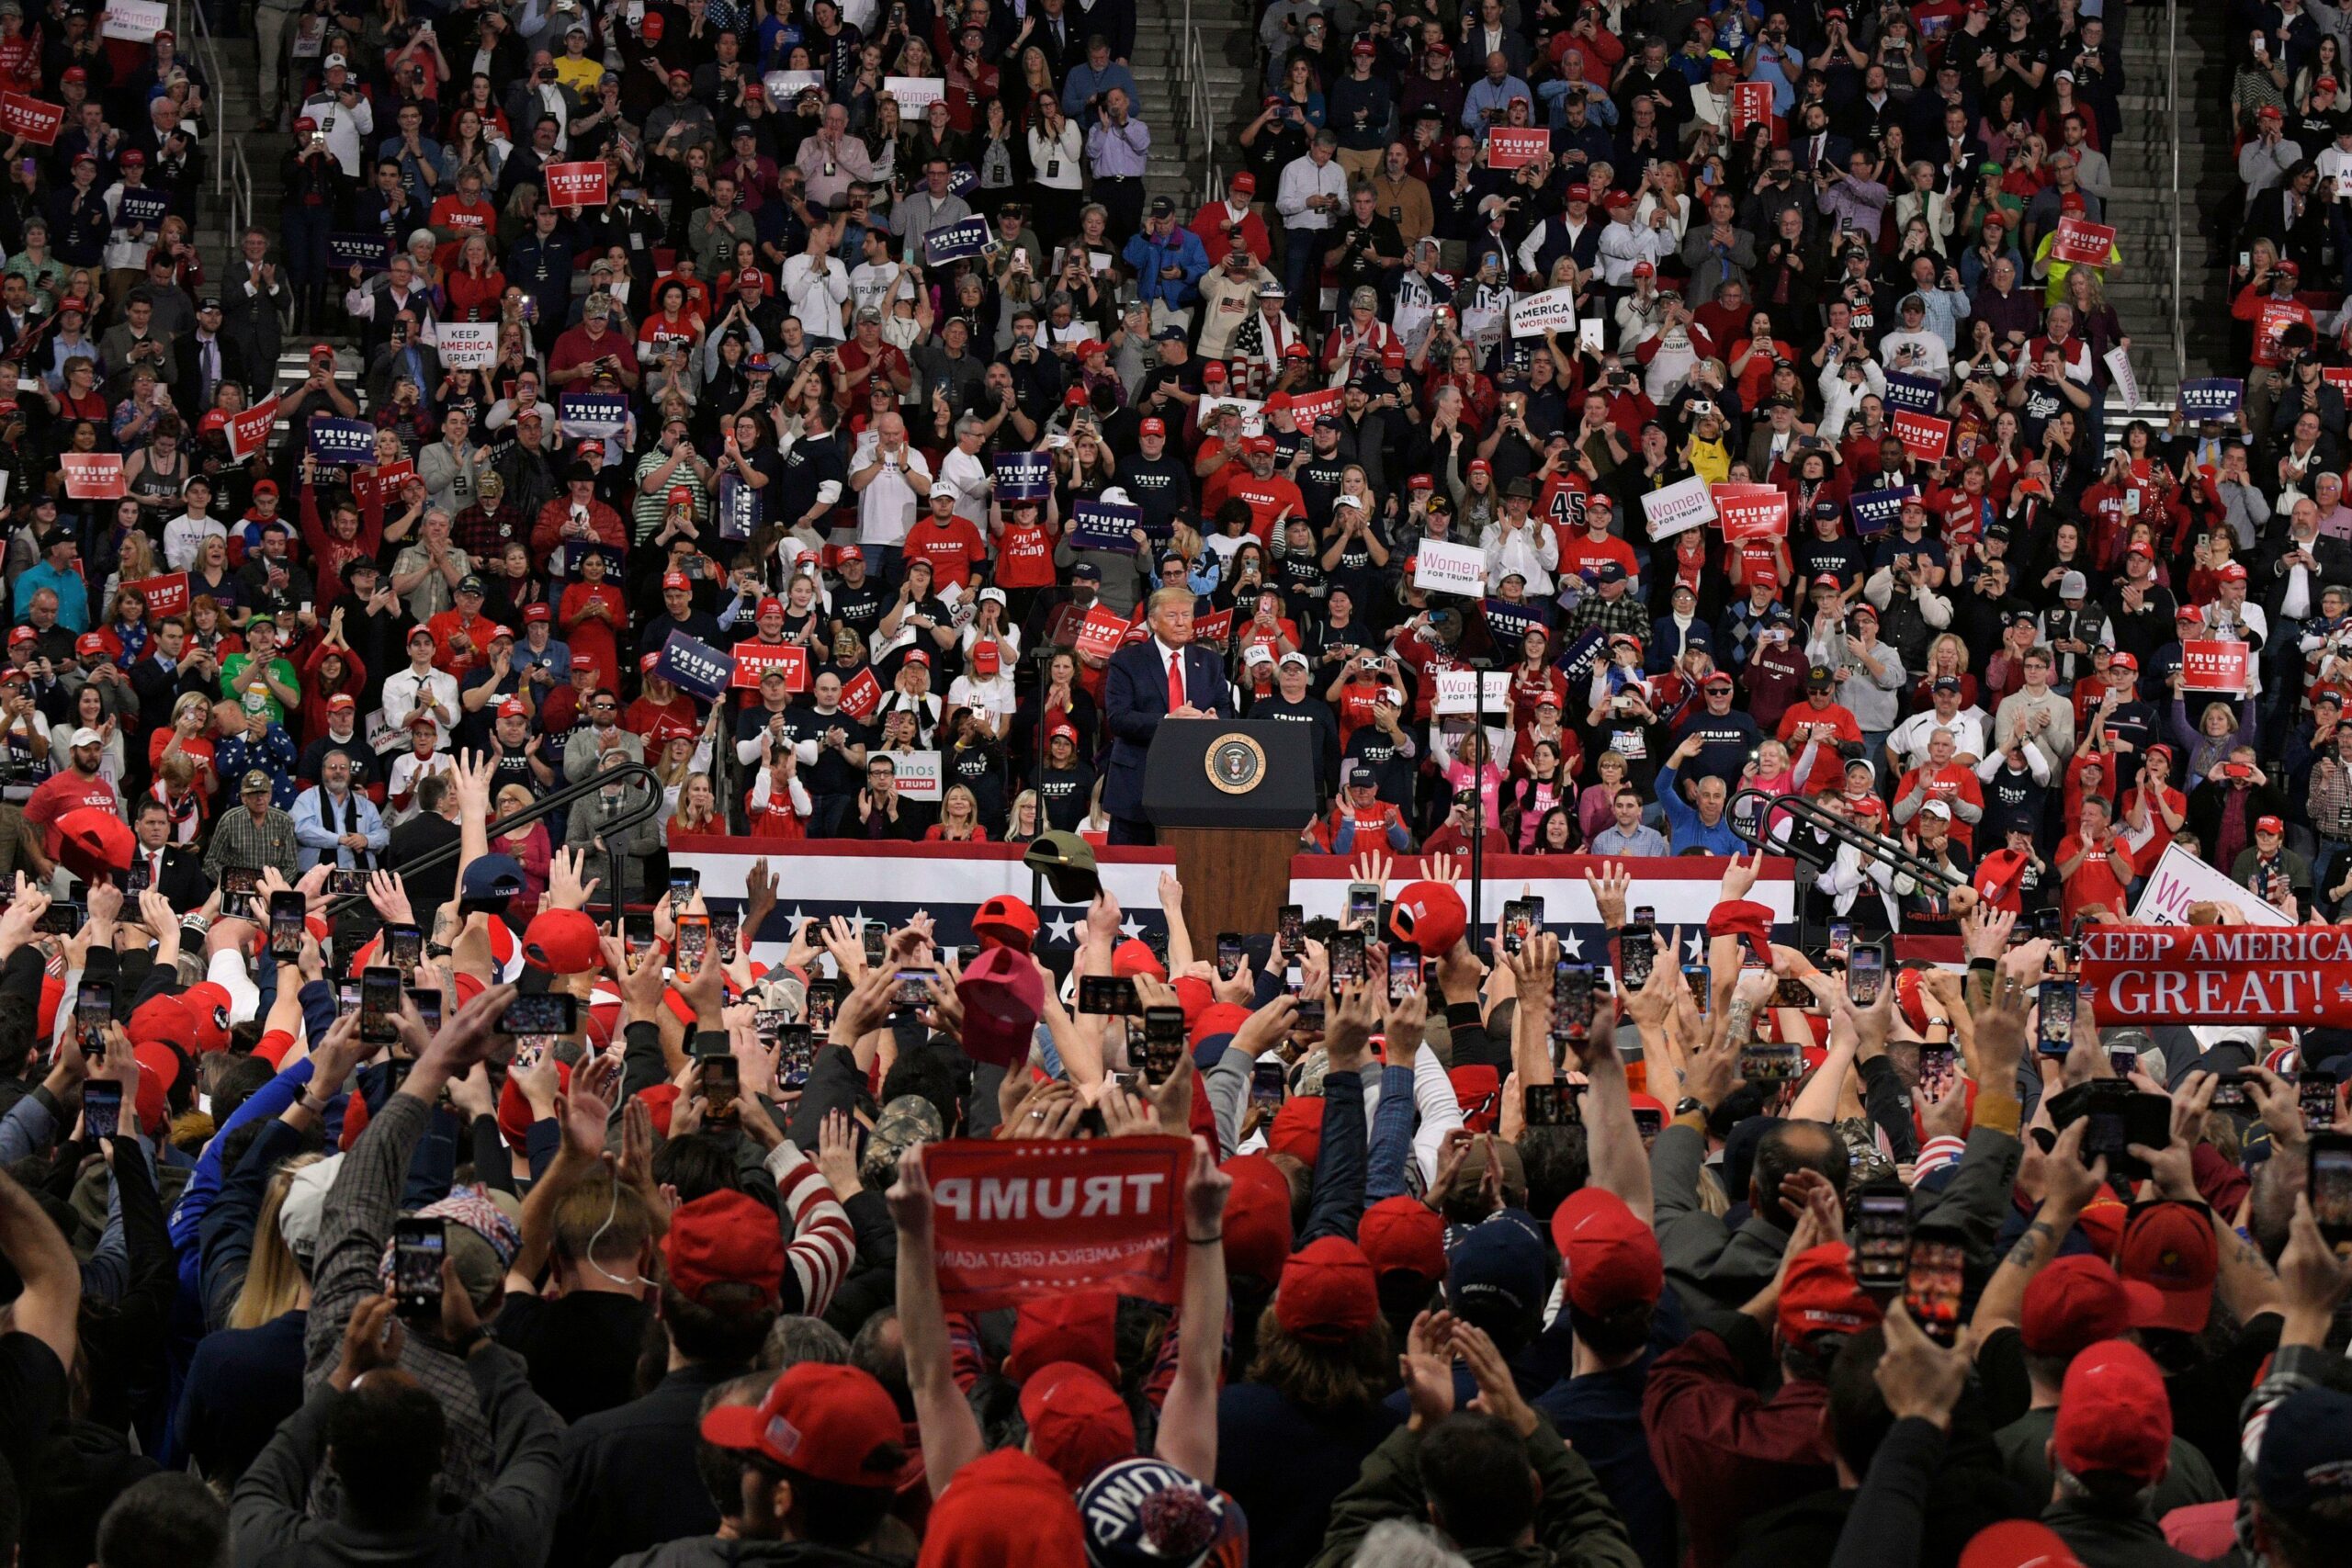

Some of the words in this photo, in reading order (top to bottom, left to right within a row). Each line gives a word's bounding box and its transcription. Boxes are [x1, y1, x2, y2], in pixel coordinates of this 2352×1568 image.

[5, 105, 55, 123] TRUMP
[7, 114, 49, 130] PENCE
[1494, 139, 1545, 148] TRUMP
[552, 174, 603, 185] TRUMP
[125, 199, 166, 210] TRUMP
[450, 214, 483, 223] TRUMP
[930, 229, 982, 247] TRUMP
[935, 236, 979, 249] PENCE
[2064, 230, 2108, 246] TRUMP
[331, 240, 385, 251] TRUMP
[2064, 238, 2101, 251] PENCE
[337, 247, 381, 256] PENCE
[854, 285, 888, 293] TRUMP
[1527, 294, 1553, 307] KEEP
[1514, 303, 1570, 320] AMERICA
[1518, 316, 1568, 329] WORKING
[451, 331, 480, 339] KEEP
[441, 341, 493, 351] AMERICA
[447, 353, 486, 363] GREAT!
[1886, 384, 1935, 396] TRUMP
[2183, 390, 2237, 400] TRUMP
[1890, 393, 1929, 403] PENCE
[565, 405, 622, 414] TRUMP
[1291, 399, 1342, 416] TRUMP
[237, 409, 277, 435] TRUMP
[314, 429, 373, 442] TRUMP
[1897, 423, 1944, 438] TRUMP
[320, 439, 368, 448] PENCE
[1898, 432, 1938, 446] PENCE
[68, 466, 119, 475] TRUMP
[997, 466, 1048, 474] TRUMP
[144, 484, 177, 494] TRUMP
[1241, 492, 1275, 502] TRUMP
[742, 484, 751, 537] TRUMP
[1550, 491, 1587, 525] 45
[1649, 491, 1705, 521] Women
[1856, 499, 1901, 513] TRUM
[1659, 516, 1675, 525] FOR
[1676, 506, 1703, 520] TRUMP
[1726, 506, 1783, 519] TRUMP
[1863, 508, 1899, 518] PENC
[1079, 514, 1136, 528] TRUMP
[1731, 515, 1778, 524] PENCE
[1083, 524, 1129, 535] PENCE
[1423, 552, 1481, 574] Women
[148, 585, 184, 599] UMP
[842, 602, 878, 612] TRUMP
[1490, 621, 1523, 633] PENC
[1250, 649, 1265, 658] USA
[1286, 653, 1300, 661] USA
[1562, 637, 1604, 678] TRUMP
[2186, 653, 2242, 663] TRUMP
[670, 644, 726, 677] TRUMP
[740, 656, 799, 667] TRUMP
[670, 656, 717, 683] PENCE
[744, 666, 793, 675] PEE
[1763, 660, 1795, 674] HOLLISTER
[2190, 663, 2236, 671] PENCE
[842, 681, 872, 708] UMP
[1273, 714, 1313, 722] TRUMP
[895, 762, 934, 776] tinos
[900, 780, 933, 789] TRUMP
[83, 796, 112, 805] KEEP
[1354, 820, 1385, 828] RUMP
[2080, 933, 2174, 961] KEEP
[2186, 933, 2352, 962] AMERICA
[2109, 970, 2324, 1015] GREAT!
